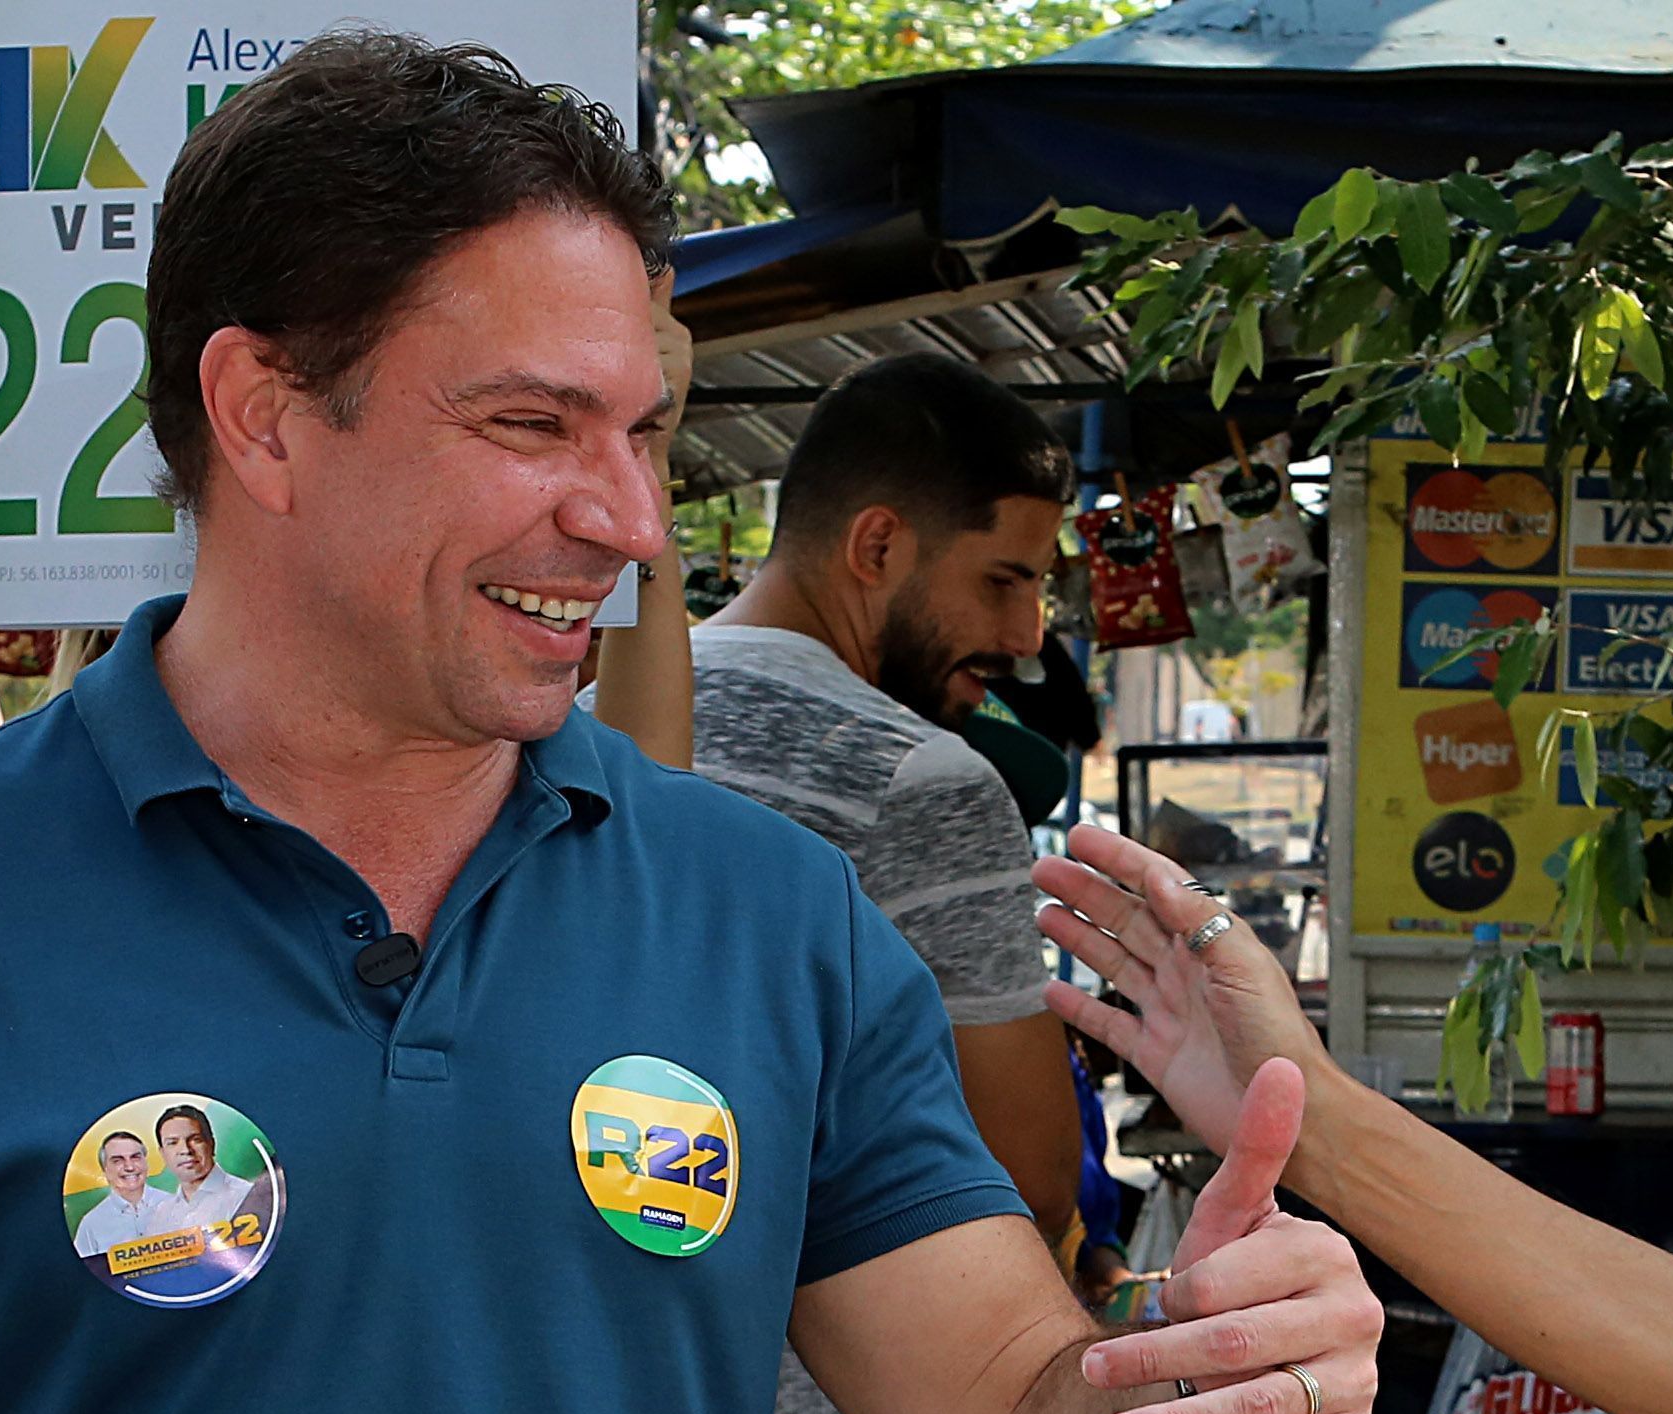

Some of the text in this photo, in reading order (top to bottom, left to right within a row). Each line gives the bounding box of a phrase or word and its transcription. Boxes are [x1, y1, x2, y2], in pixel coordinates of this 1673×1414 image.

[1412, 505, 1553, 537] MasterCrd
[1422, 735, 1514, 772] Hiper
[1424, 840, 1505, 880] elo
[584, 1110, 730, 1199] R22
[204, 1212, 263, 1252] 22
[642, 1207, 684, 1225] RAMAGEM
[115, 1234, 197, 1262] RAMAGEM
